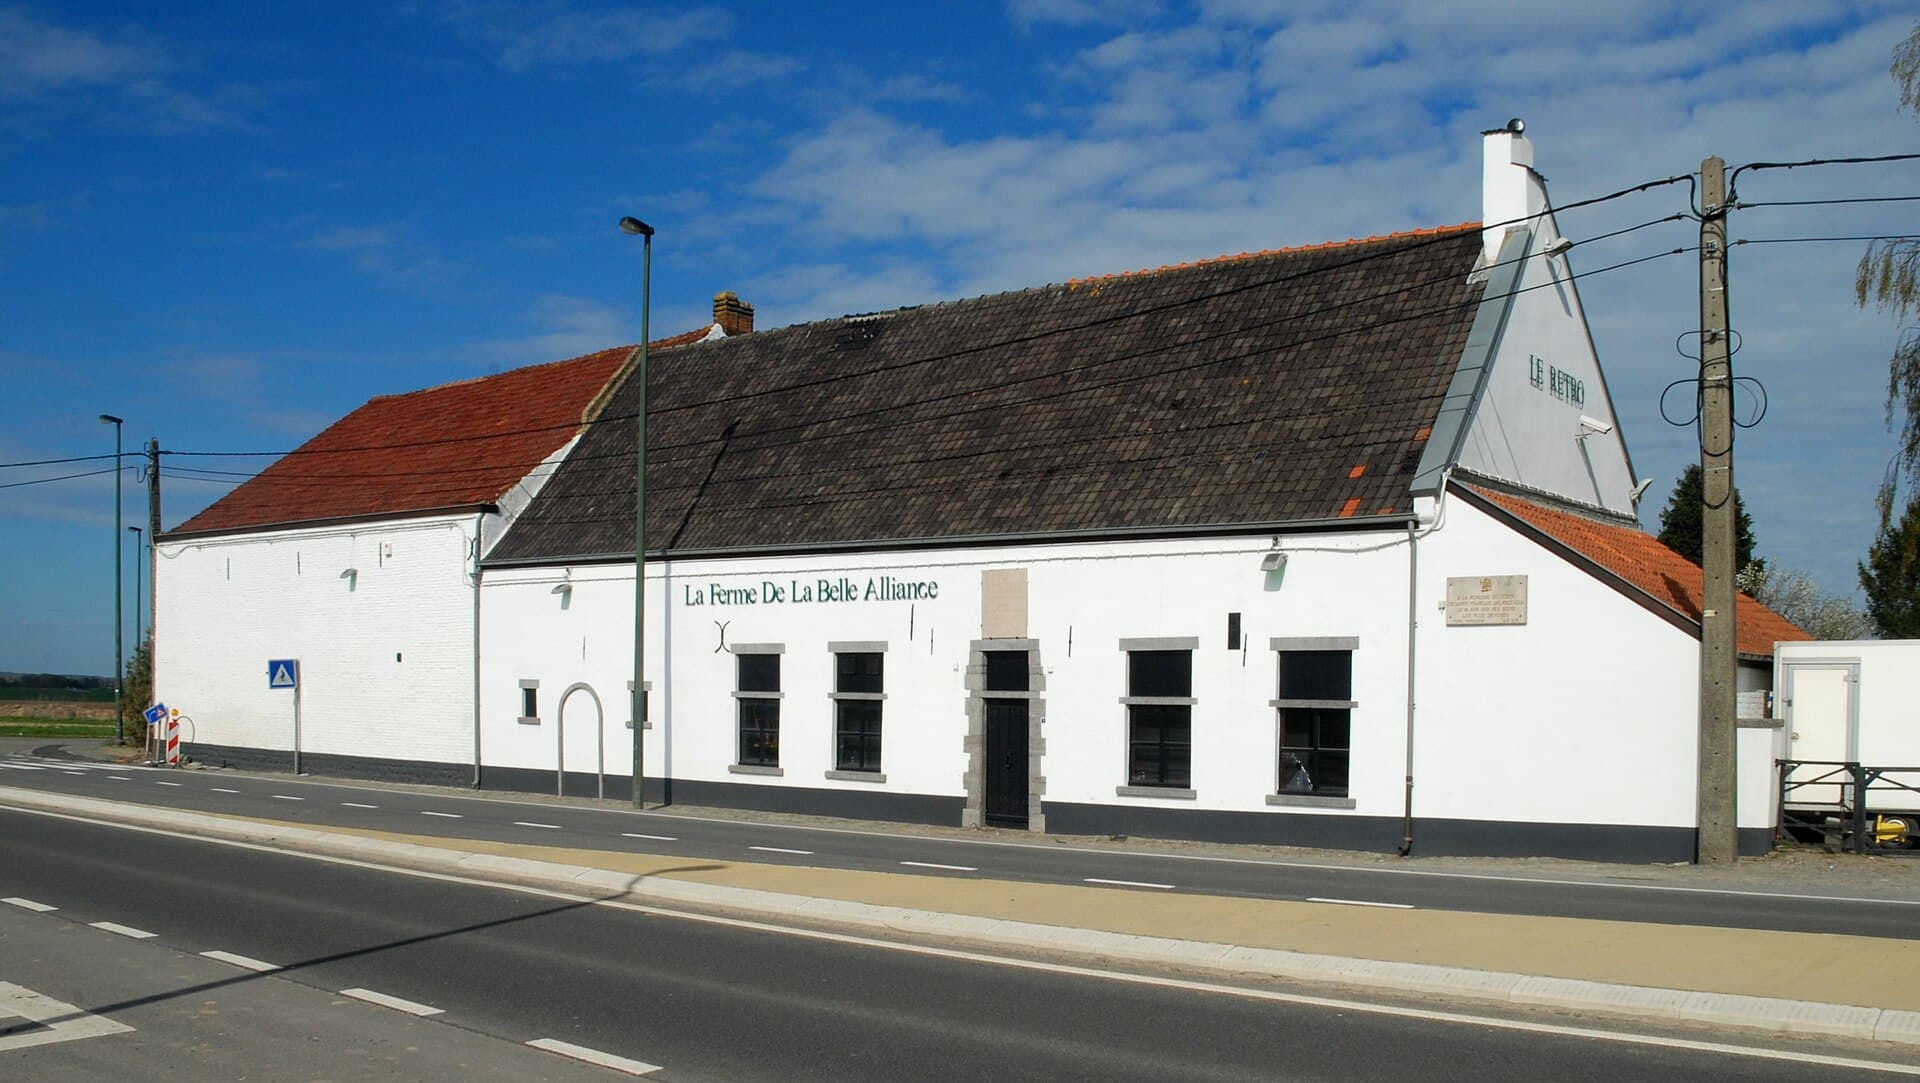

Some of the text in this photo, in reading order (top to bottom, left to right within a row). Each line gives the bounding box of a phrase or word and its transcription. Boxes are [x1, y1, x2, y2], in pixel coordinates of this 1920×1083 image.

[1530, 354, 1584, 404] LE RETRO
[685, 576, 938, 606] La Ferme De La Belle Alliance
